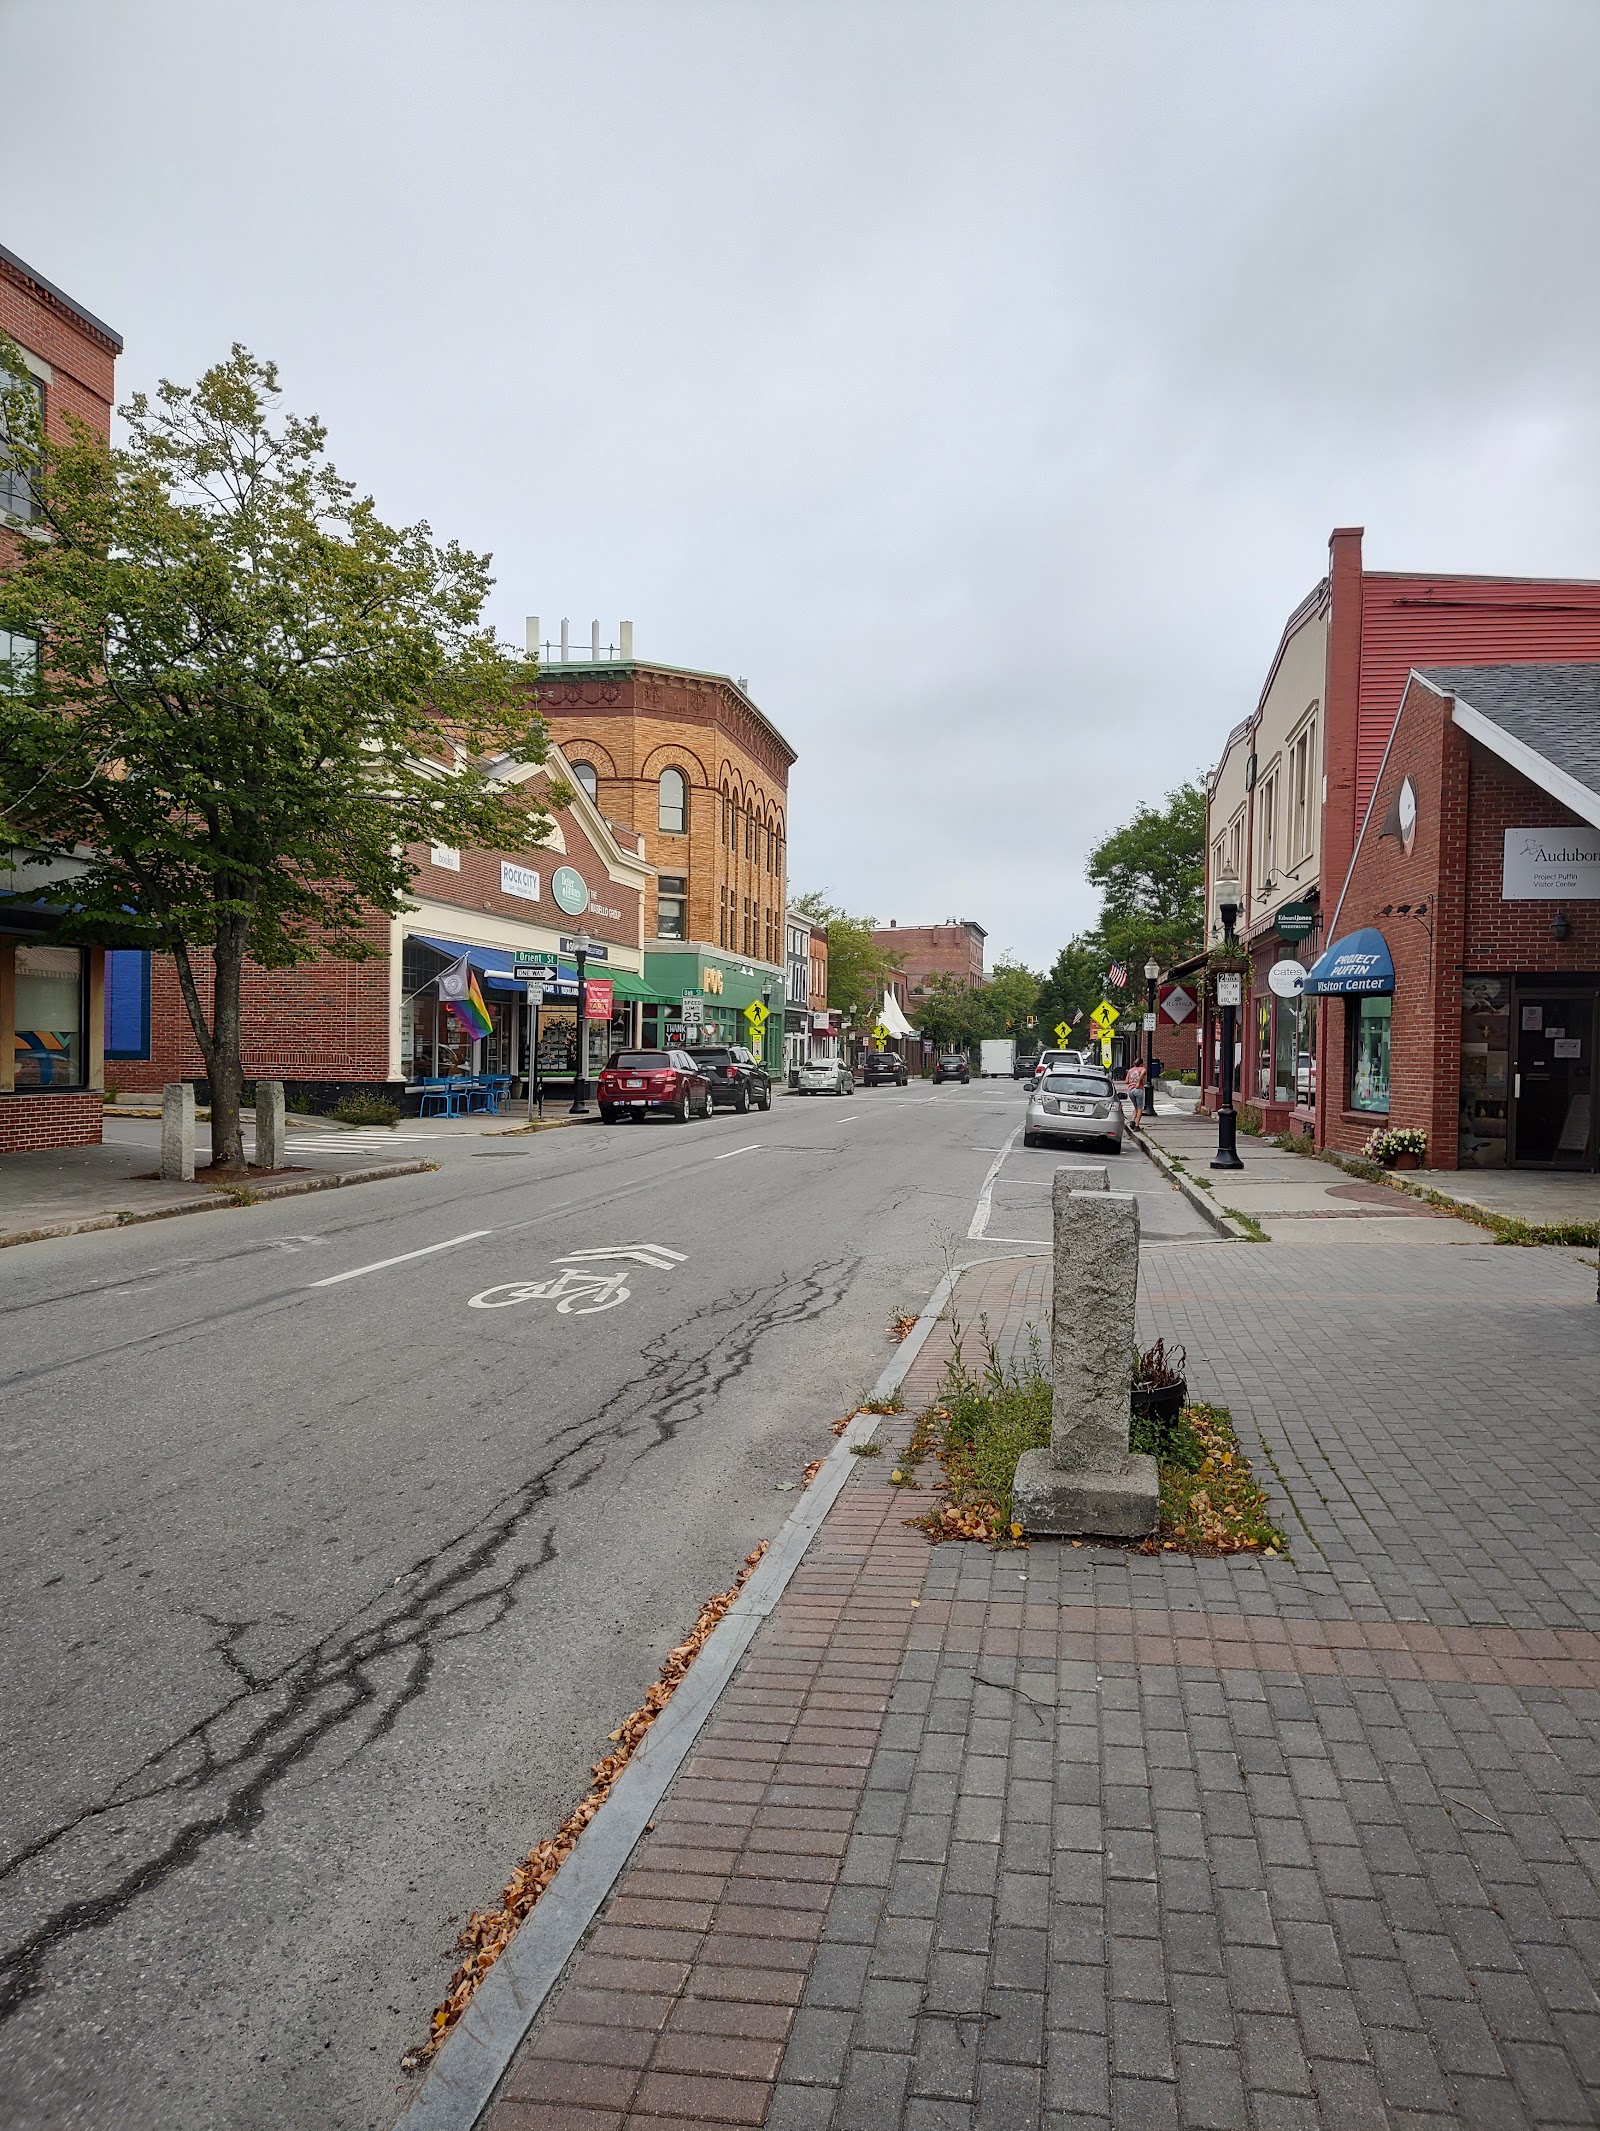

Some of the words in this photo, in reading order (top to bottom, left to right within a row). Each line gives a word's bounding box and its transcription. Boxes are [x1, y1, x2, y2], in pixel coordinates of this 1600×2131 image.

[1535, 848, 1600, 862] Audubon
[504, 866, 522, 885] ROCK
[522, 873, 536, 888] CITY
[520, 952, 542, 962] Orient
[546, 954, 554, 963] St
[1334, 954, 1380, 965] PROJECT
[1274, 968, 1302, 976] cates
[1330, 964, 1370, 976] PUFFIN
[1318, 980, 1344, 992] Visitor
[1346, 978, 1384, 990] Center
[684, 1012, 700, 1022] 25
[665, 1024, 686, 1033] THANK
